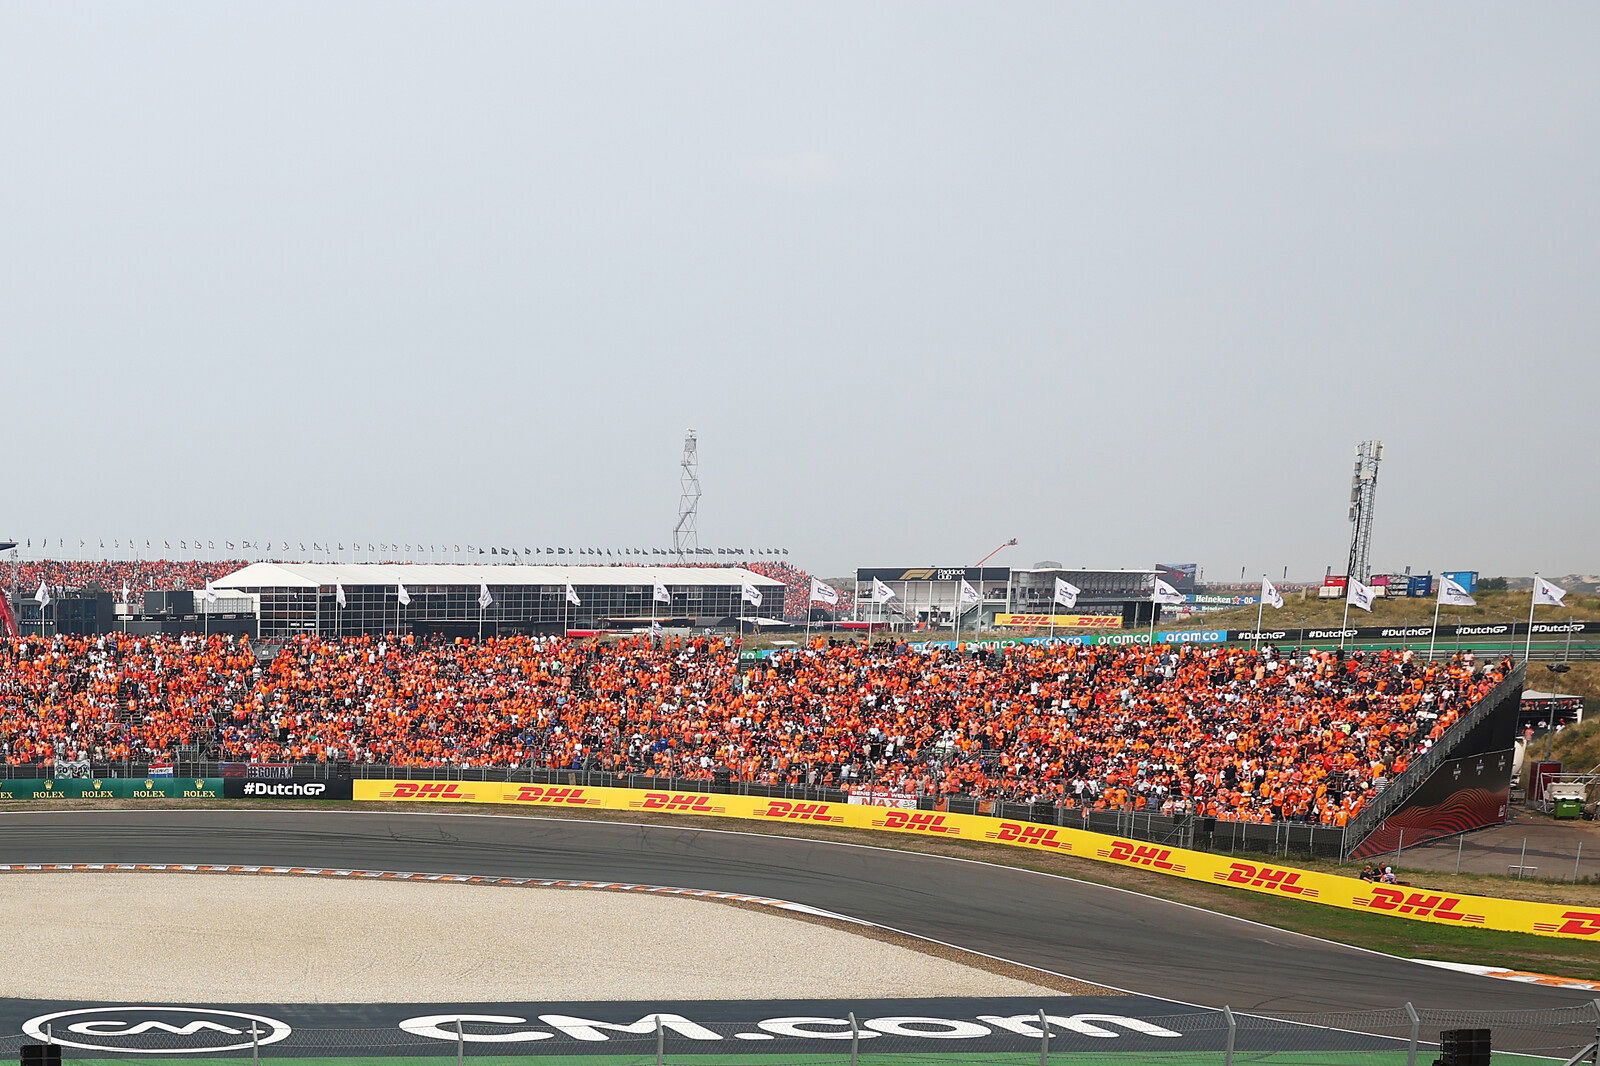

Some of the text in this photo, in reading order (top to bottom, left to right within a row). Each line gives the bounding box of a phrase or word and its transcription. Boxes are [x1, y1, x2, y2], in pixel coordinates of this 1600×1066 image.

[1196, 594, 1231, 604] Heineken
[1009, 615, 1052, 625] DHL
[1076, 617, 1121, 627] DHL
[1381, 628, 1432, 637] #DutchGP
[1456, 626, 1508, 635] #DutchGP
[1531, 624, 1586, 632] #DutchGP
[1166, 632, 1219, 642] aramco
[1238, 632, 1286, 640] #DutchGP
[1308, 630, 1358, 638] #DutchGP
[1098, 634, 1150, 645] aramco
[82, 790, 114, 798] ROLEX
[133, 790, 165, 798] ROLEX
[183, 790, 215, 798] ROLEX
[243, 782, 326, 796] #DutchGP
[392, 783, 463, 799] DHL
[33, 790, 65, 799] ROLEX
[516, 786, 587, 804] DHL
[643, 793, 714, 812] DHL
[767, 801, 834, 822] DHL
[884, 811, 950, 834] DHL
[997, 823, 1062, 849] DHL
[1108, 841, 1174, 870] DHL
[1226, 863, 1305, 895] DHL
[1365, 887, 1465, 922] DHL
[398, 1012, 1185, 1042] CM.com
